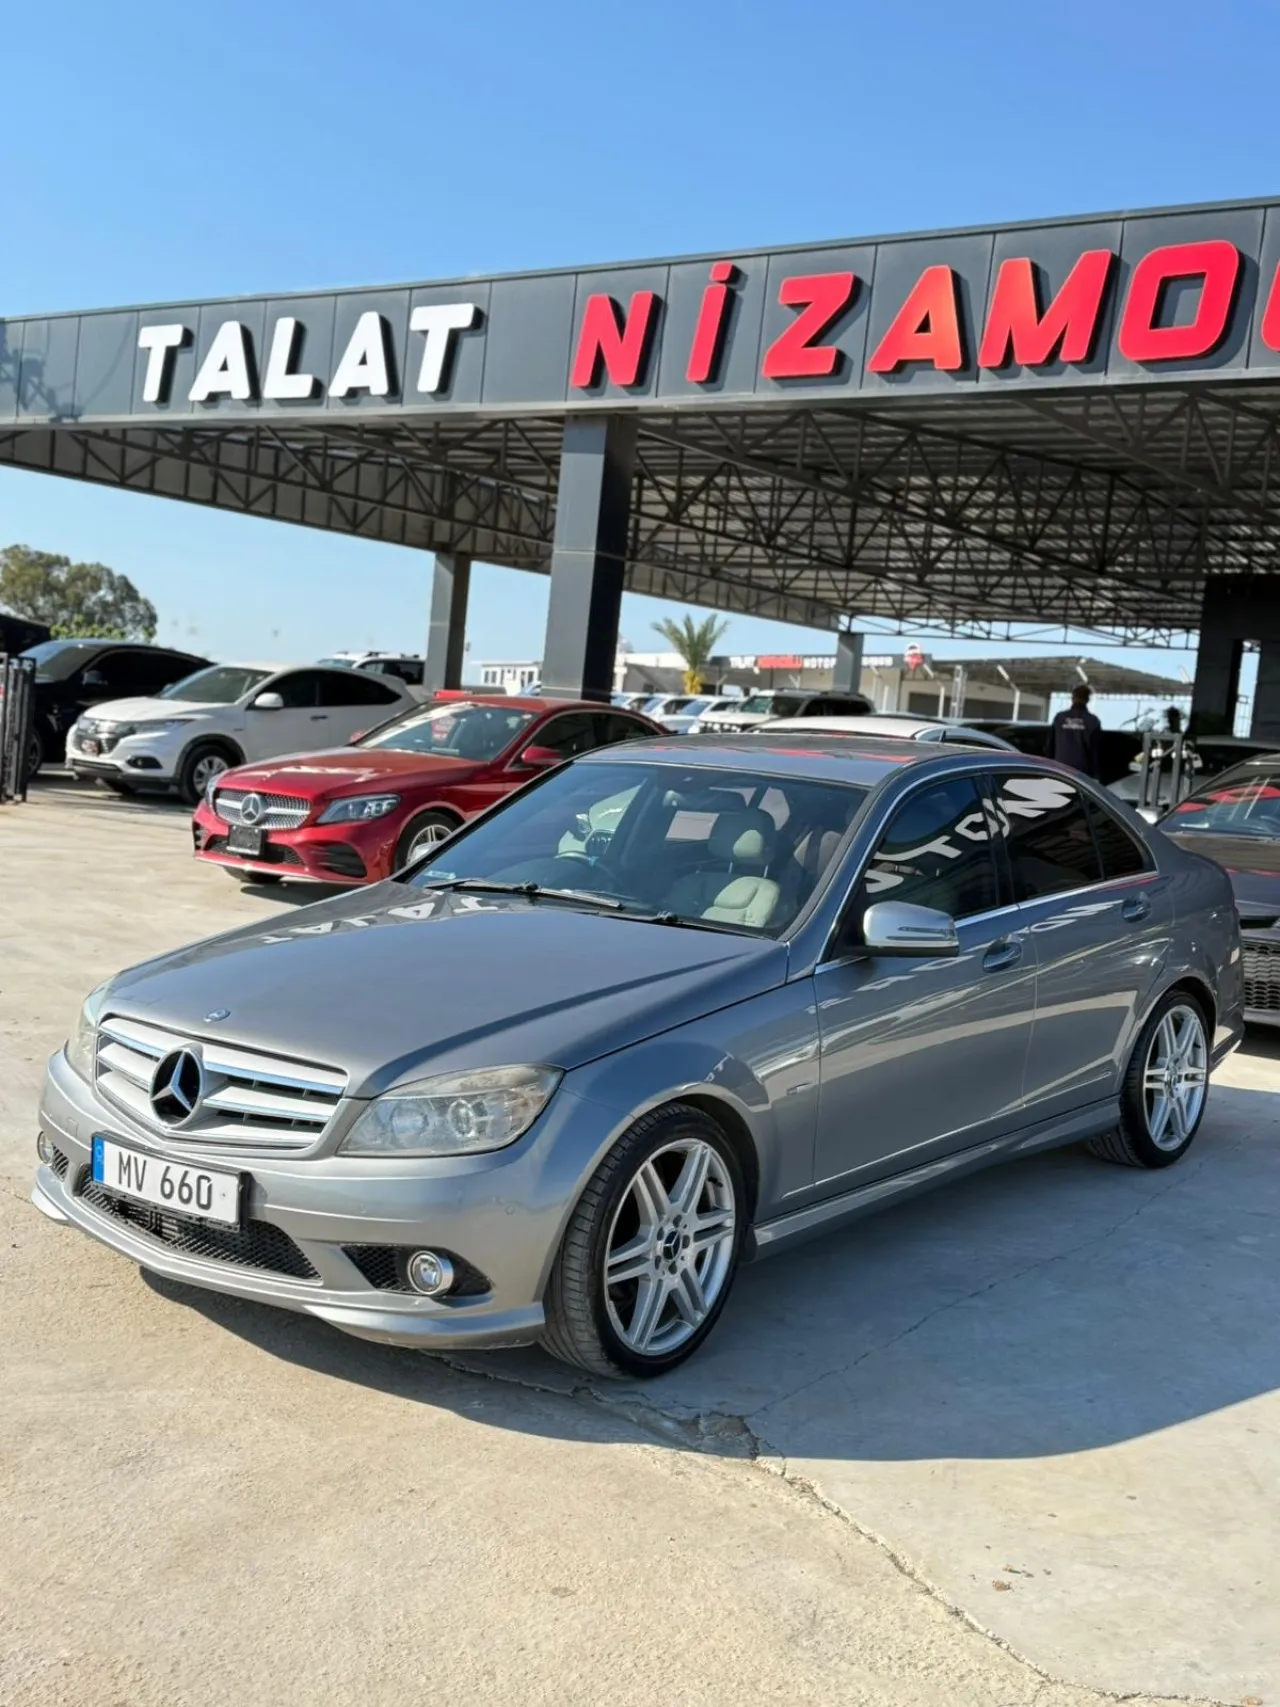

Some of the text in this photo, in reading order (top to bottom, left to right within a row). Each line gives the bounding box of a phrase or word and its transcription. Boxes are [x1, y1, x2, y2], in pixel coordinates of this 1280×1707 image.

[138, 240, 1280, 401] TALAT NİZAMO
[118, 1151, 213, 1211] MV 660
